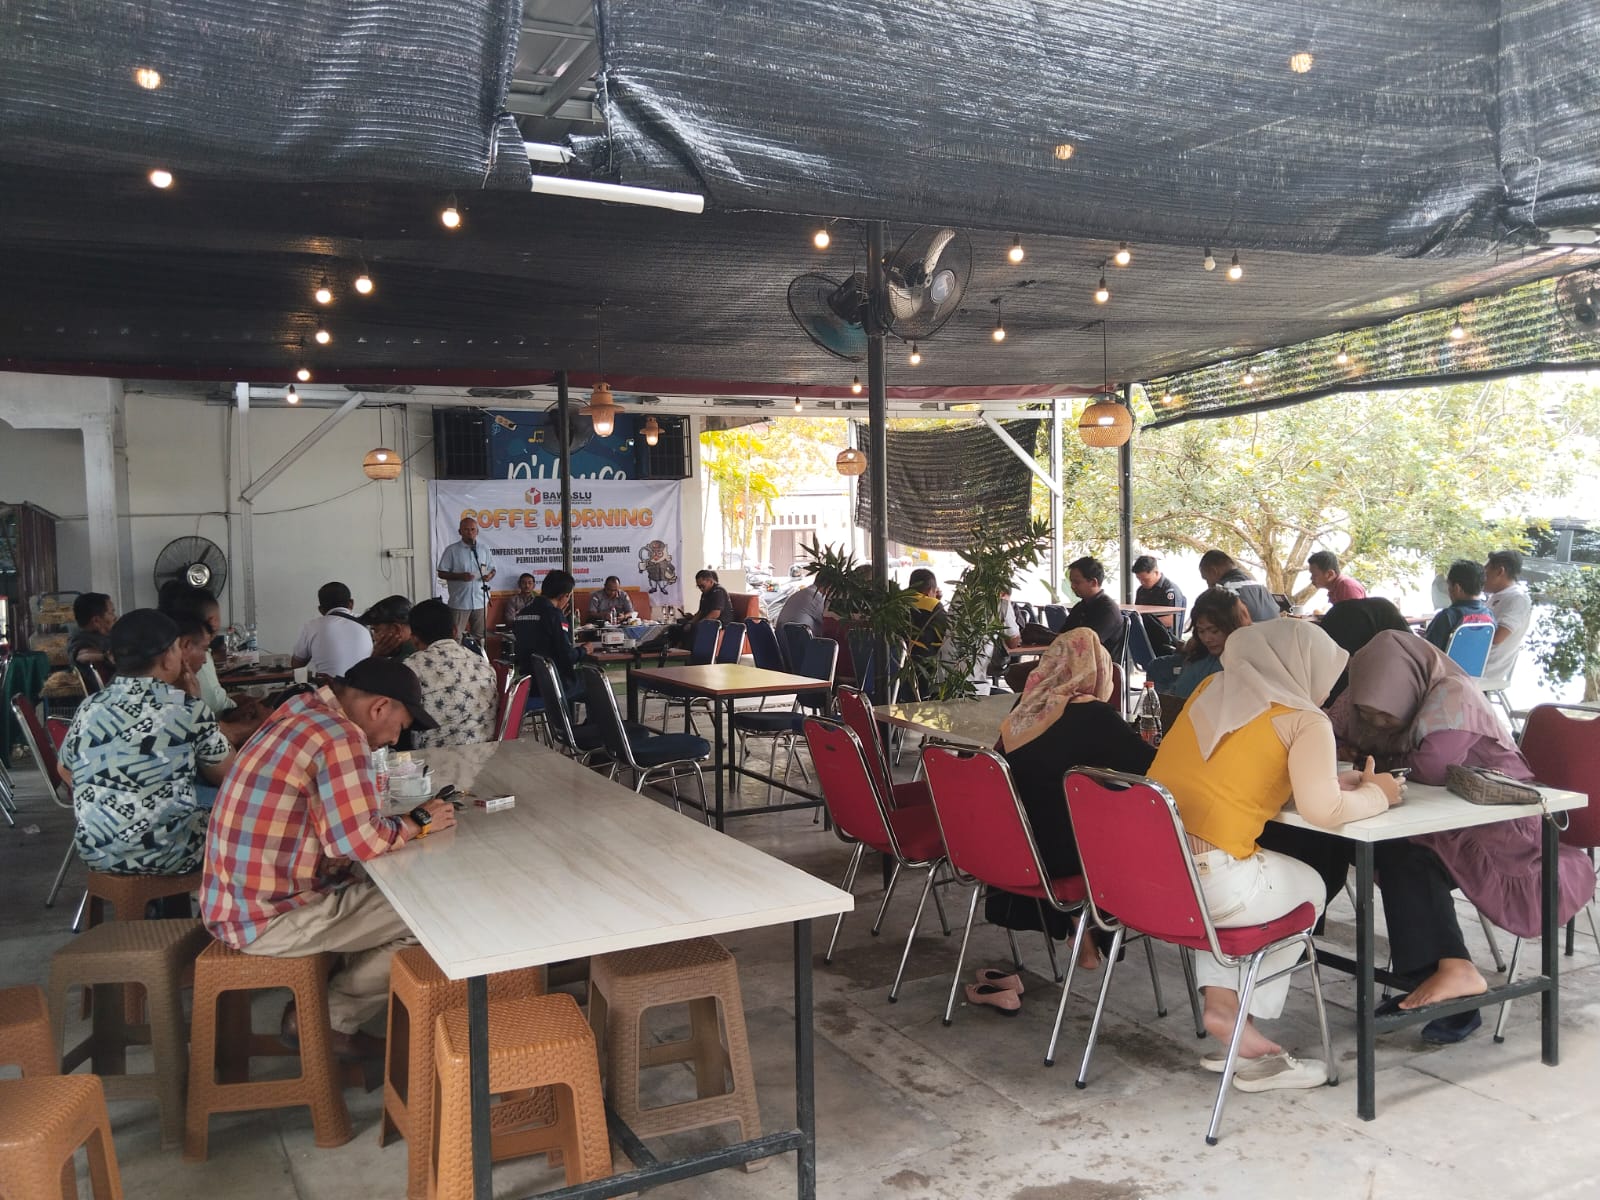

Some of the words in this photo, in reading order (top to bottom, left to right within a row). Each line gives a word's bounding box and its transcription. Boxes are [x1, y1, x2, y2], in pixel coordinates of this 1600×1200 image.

[542, 491, 592, 499] BAWSLU
[544, 507, 654, 528] MORNING
[490, 548, 523, 556] ONFERENSI
[525, 547, 541, 555] PERS
[541, 546, 581, 556] PENGAAN
[582, 546, 599, 554] MASA
[599, 545, 630, 554] KAMPANYE
[516, 556, 548, 564] PEMILIHAN
[549, 555, 563, 563] UMU
[572, 555, 588, 563] AHUN
